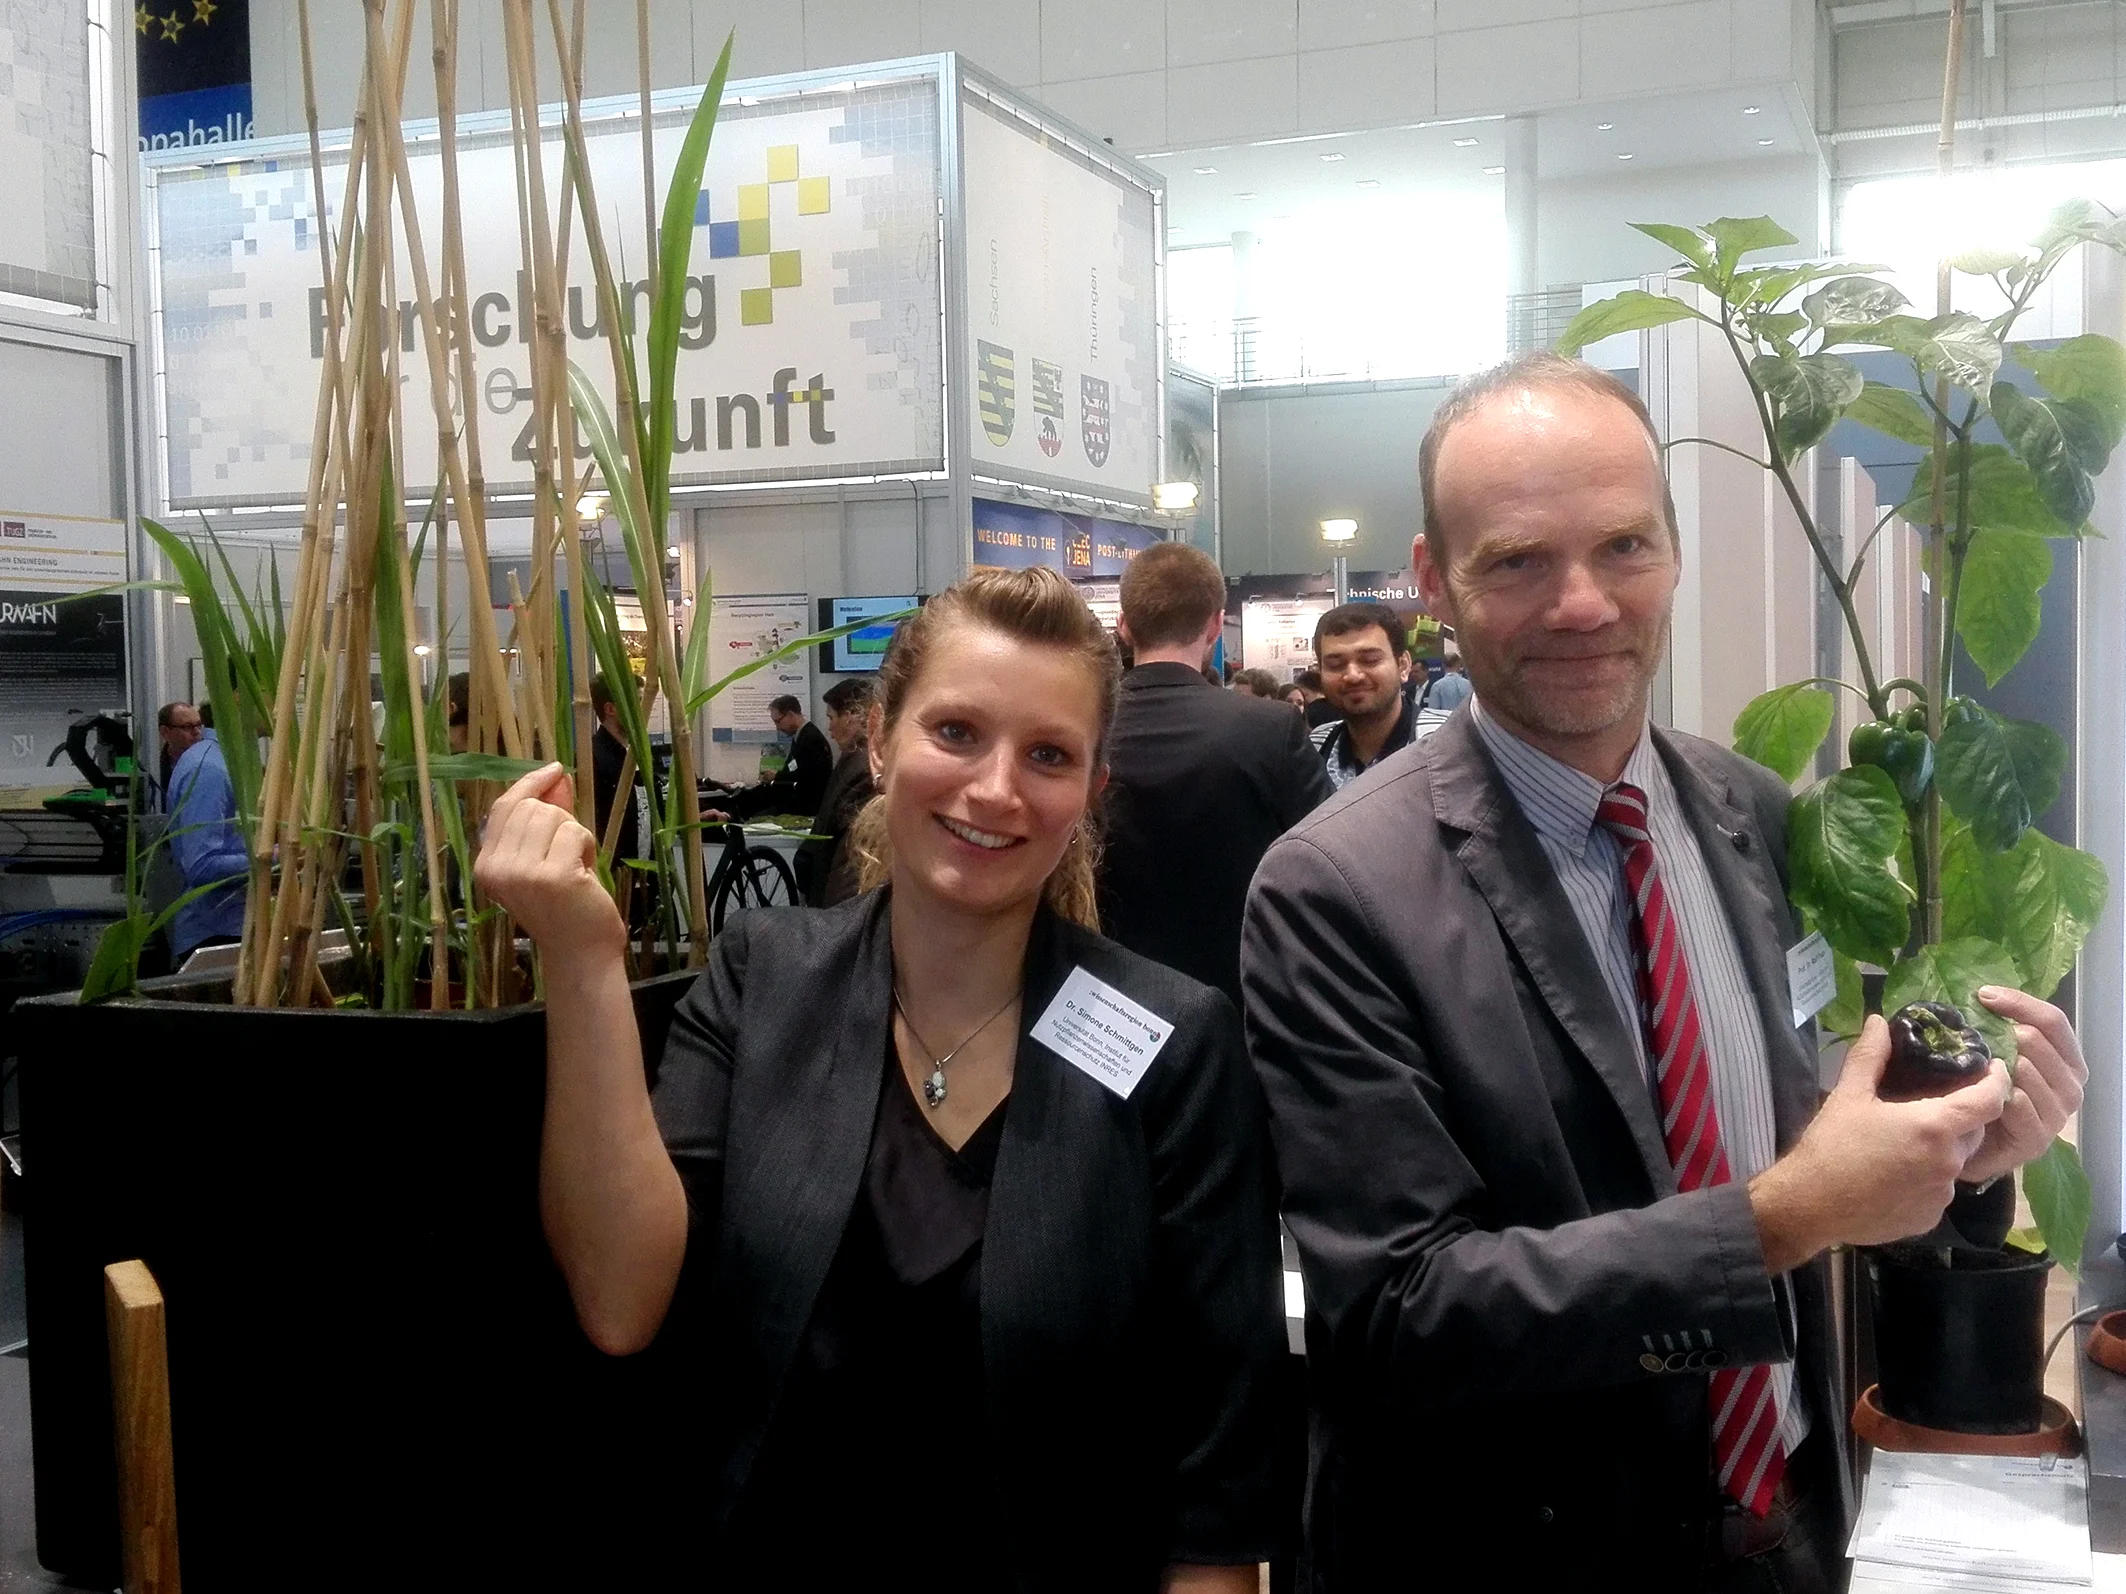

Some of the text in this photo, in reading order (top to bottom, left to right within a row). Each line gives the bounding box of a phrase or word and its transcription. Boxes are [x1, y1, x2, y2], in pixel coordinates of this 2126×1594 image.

[989, 239, 999, 327] Sachsen
[308, 269, 717, 359] Frcung
[1090, 267, 1099, 364] Thüringen
[977, 529, 1057, 551] WELCOME TO THE
[1073, 550, 1092, 567] JENA
[1347, 586, 1404, 600] hnische
[1066, 1000, 1145, 1056] Dr. Simone Schmittgen
[1104, 1043, 1122, 1059] Institut
[1099, 1060, 1120, 1078] INRES
[1120, 1065, 1133, 1076] und
